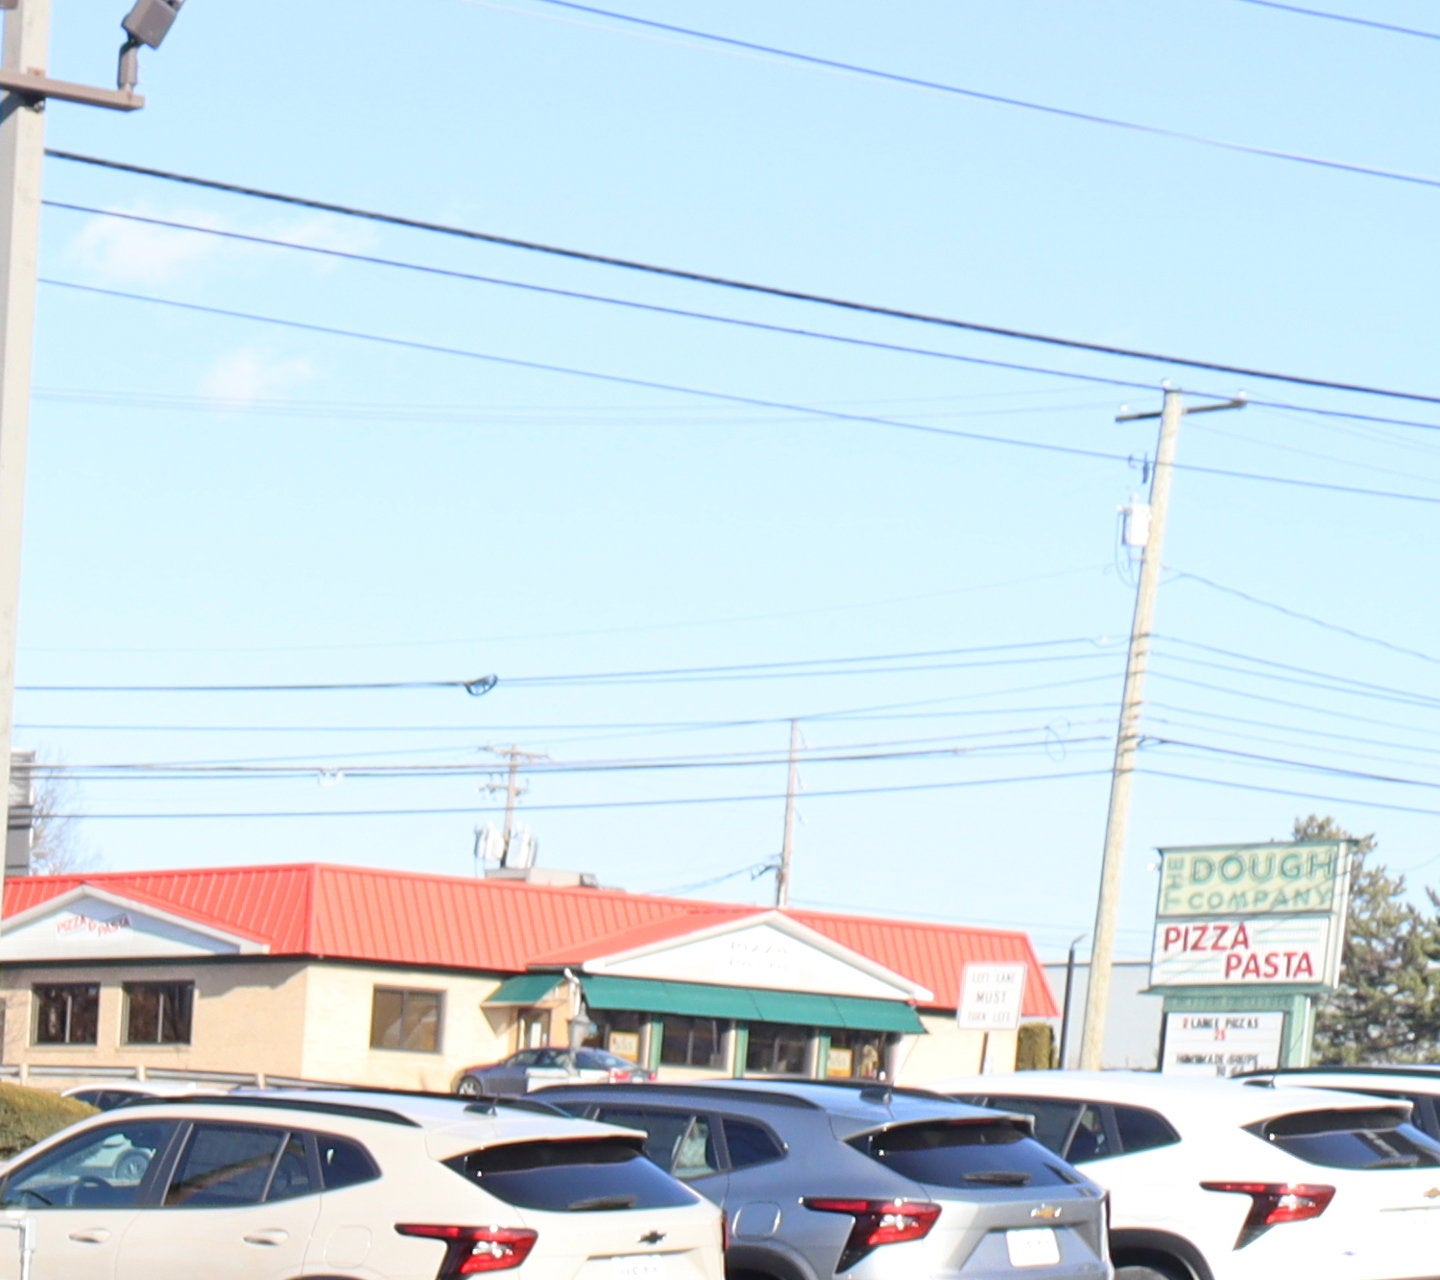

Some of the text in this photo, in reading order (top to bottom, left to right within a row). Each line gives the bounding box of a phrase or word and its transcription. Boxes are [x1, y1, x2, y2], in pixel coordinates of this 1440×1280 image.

[1189, 852, 1337, 884] DOUGH
[1164, 856, 1184, 910] THE
[1188, 887, 1331, 911] COMPANY
[1163, 922, 1249, 952] PIZZA
[1224, 952, 1314, 979] PASTA
[976, 991, 1007, 1004] MUST
